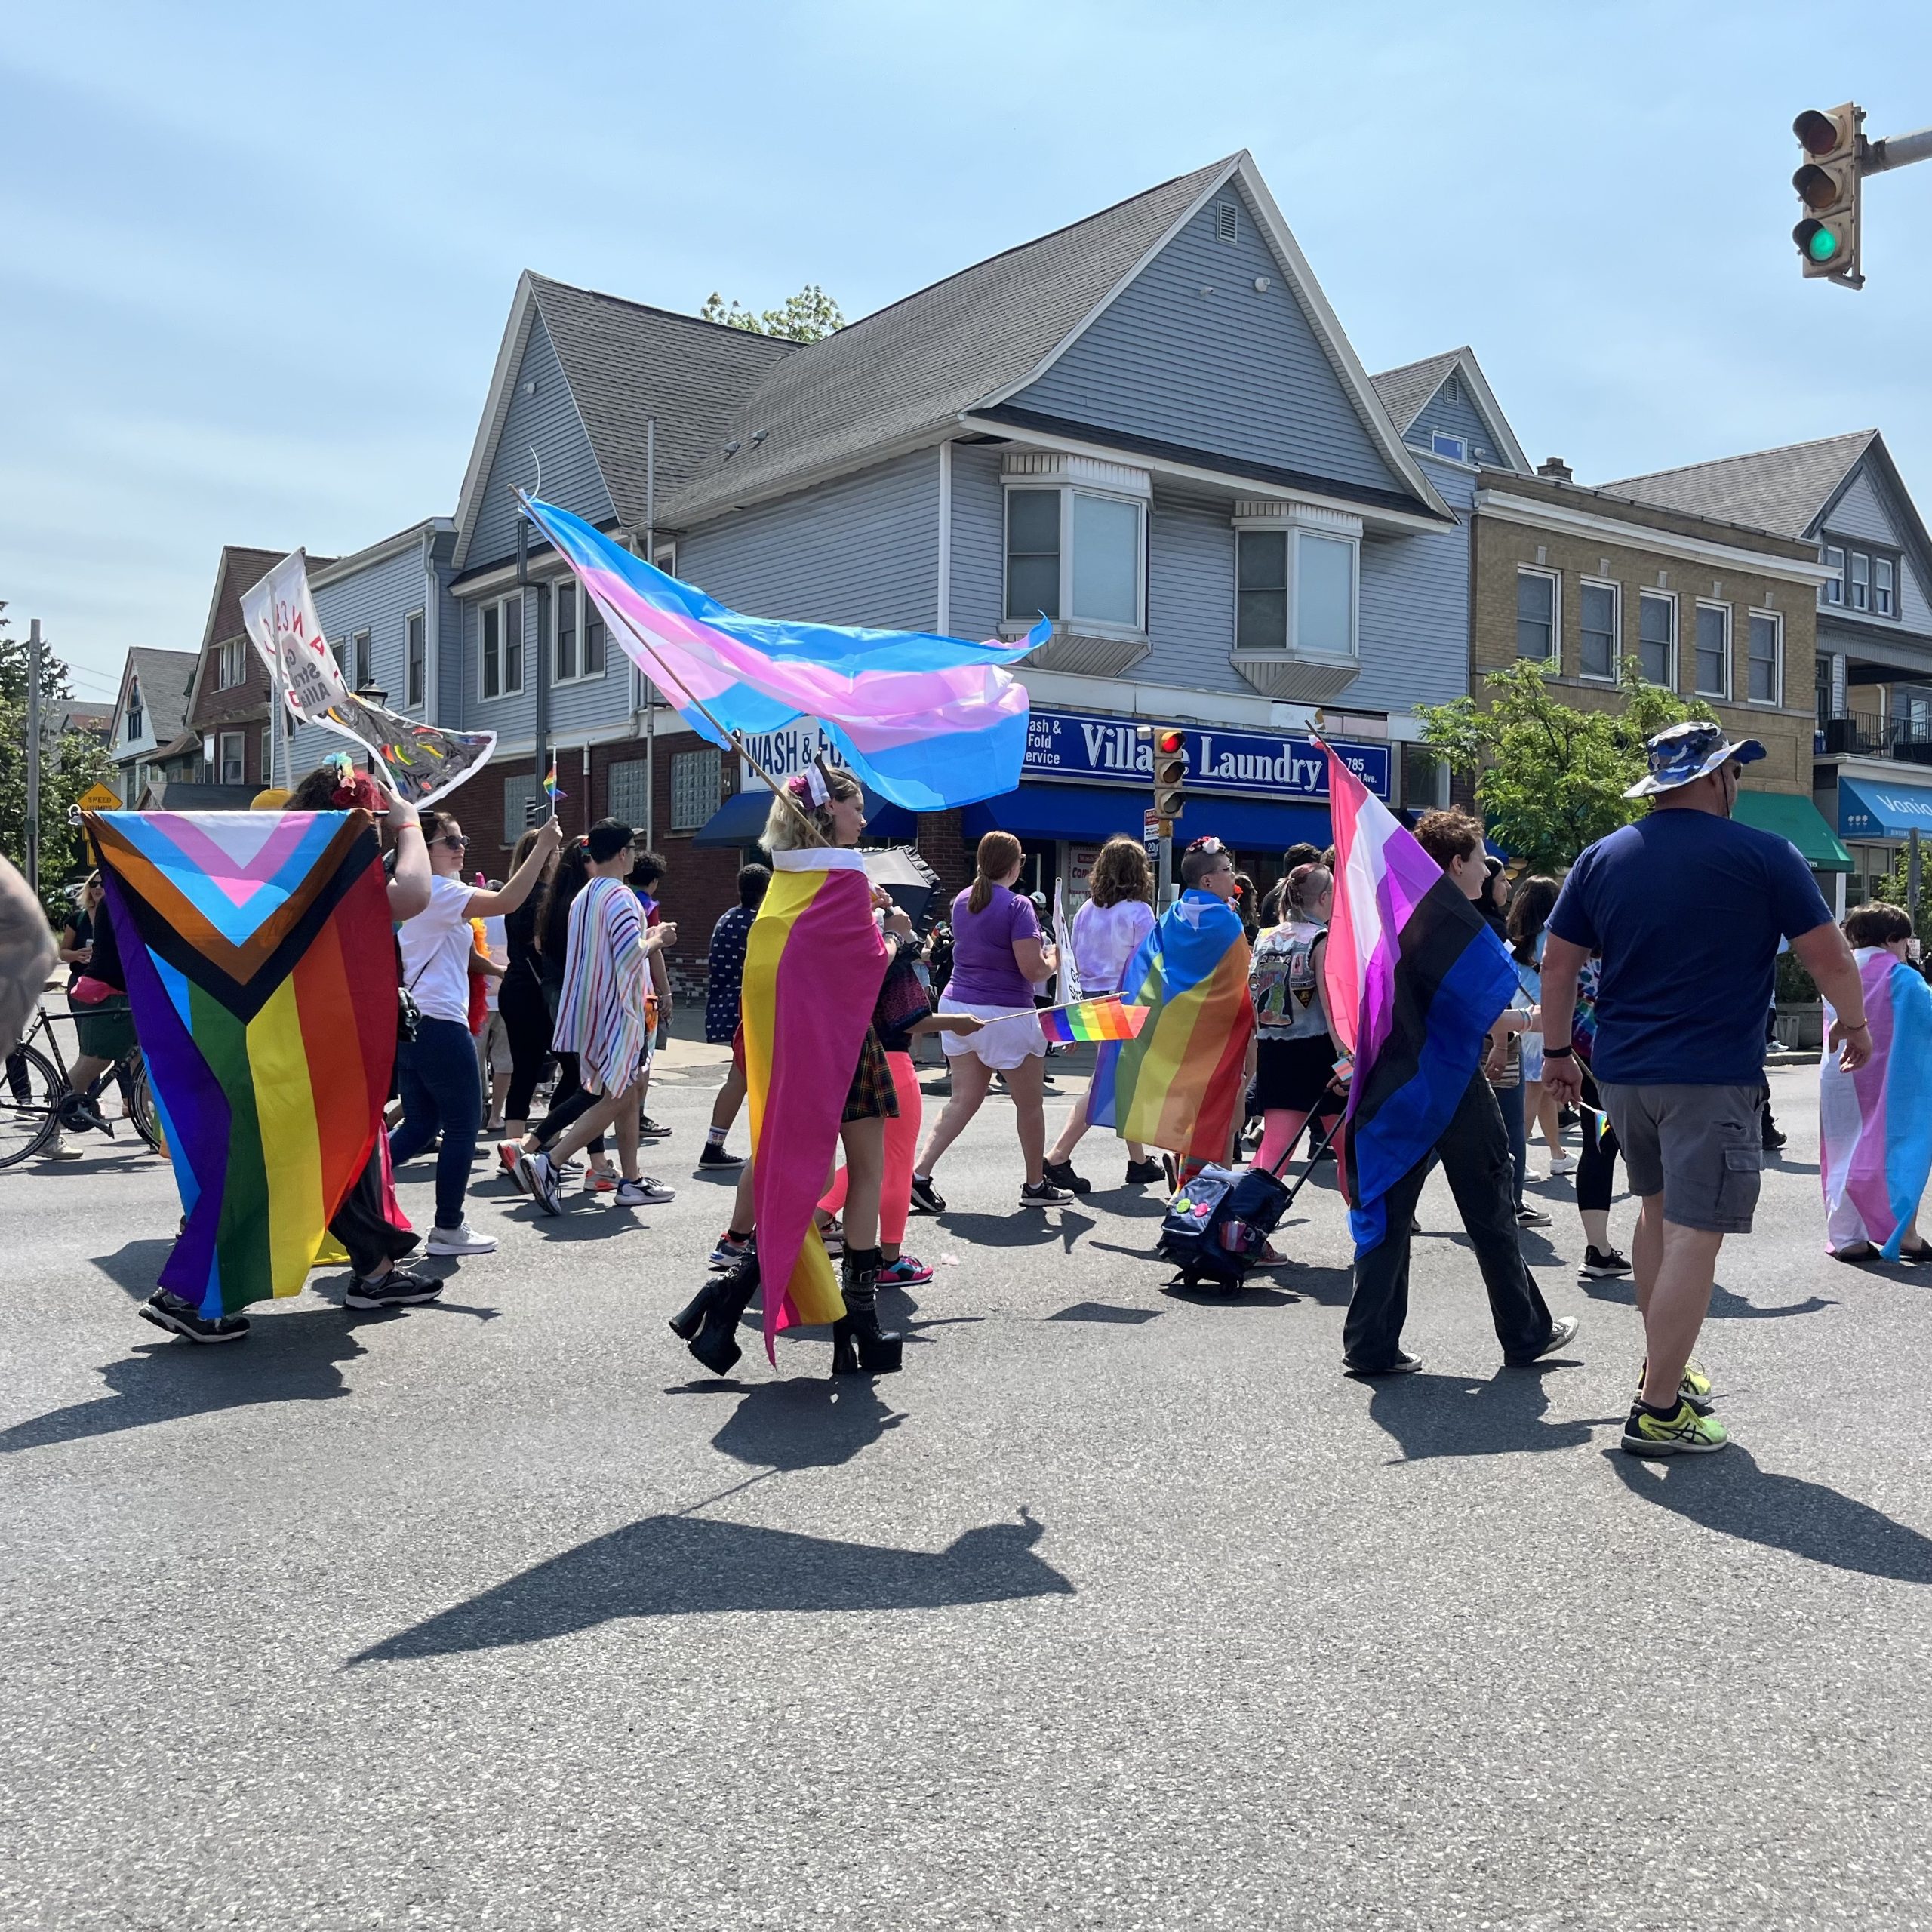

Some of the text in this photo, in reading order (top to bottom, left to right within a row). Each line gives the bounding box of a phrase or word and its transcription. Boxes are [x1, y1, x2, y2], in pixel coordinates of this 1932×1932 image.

[1029, 719, 1062, 734] ash &
[1028, 733, 1051, 749] Fold
[746, 730, 798, 777] WASH
[802, 737, 812, 764] &
[1026, 750, 1060, 765] ervice
[1081, 722, 1323, 792] Villae Laundry
[1346, 757, 1364, 771] 785
[1363, 773, 1377, 783] Ave.
